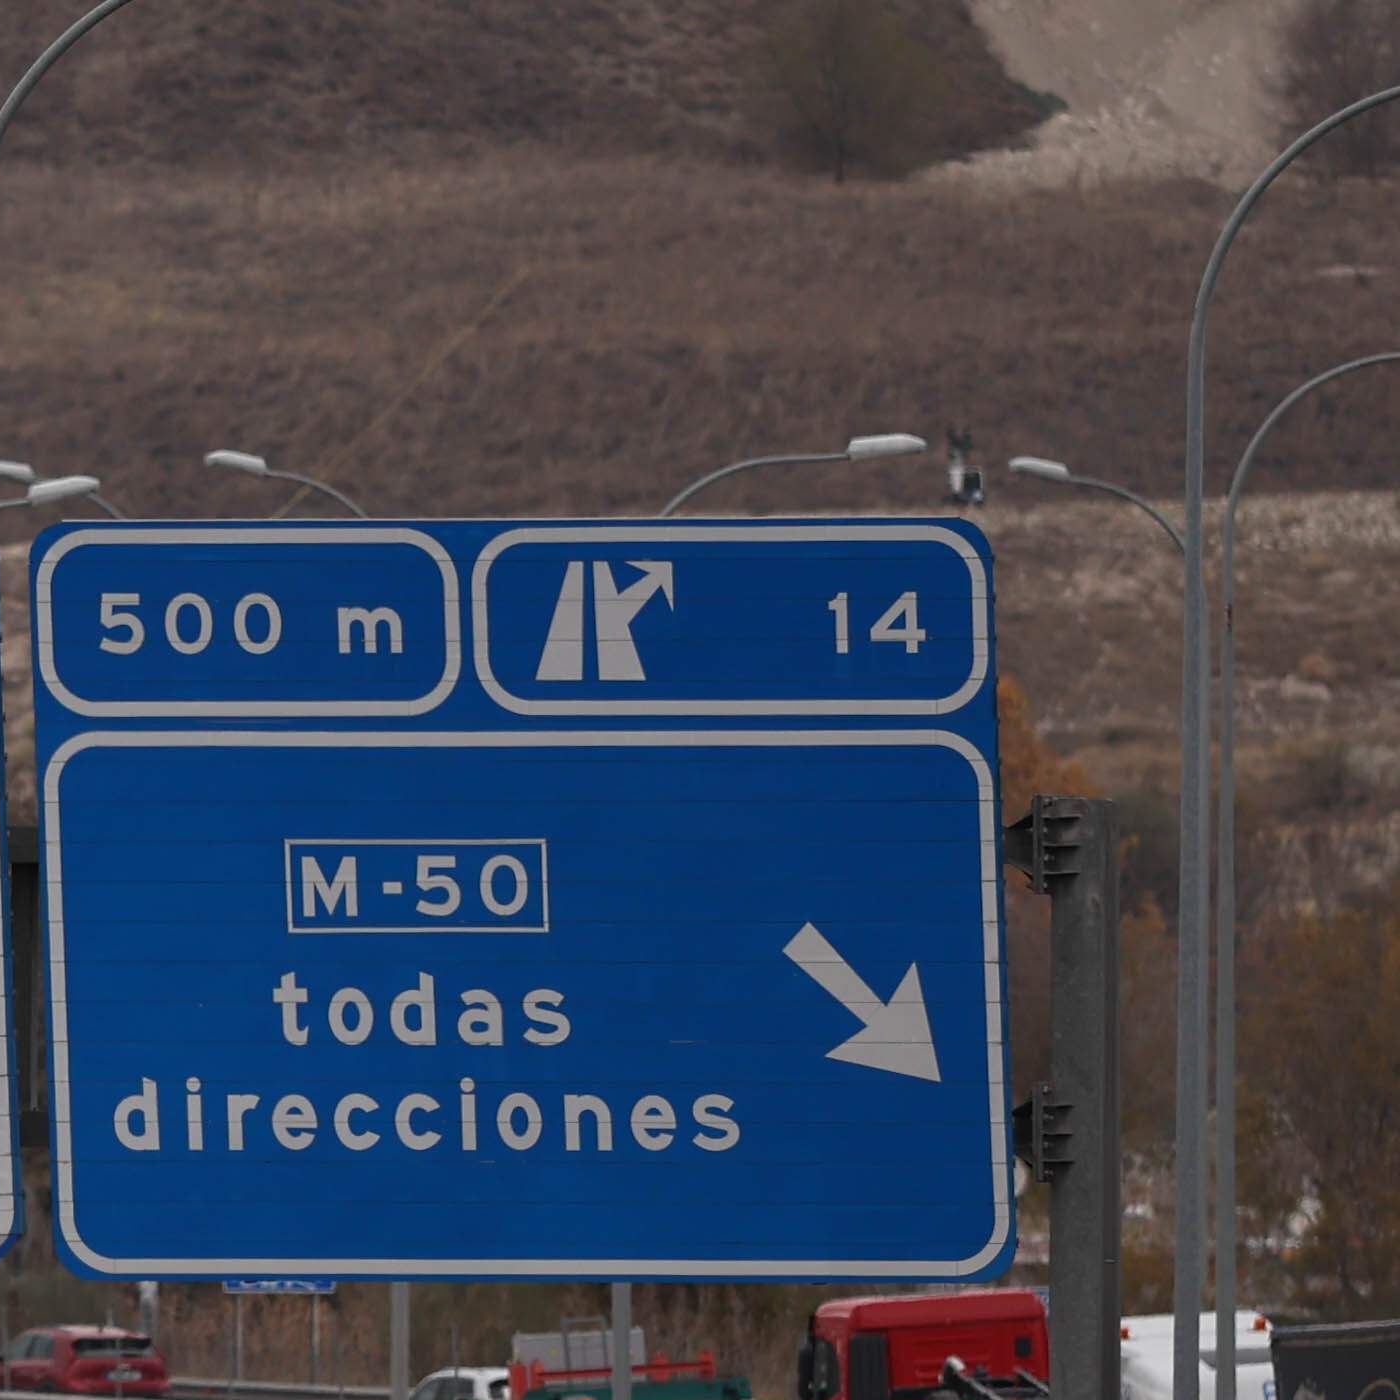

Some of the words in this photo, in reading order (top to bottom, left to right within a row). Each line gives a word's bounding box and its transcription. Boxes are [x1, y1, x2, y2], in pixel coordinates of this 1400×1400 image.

[99, 592, 282, 655] 500
[337, 606, 403, 654] m
[828, 591, 927, 654] 14
[302, 854, 529, 917] M-50
[272, 971, 571, 1047] todas
[113, 1076, 741, 1152] direcciones
